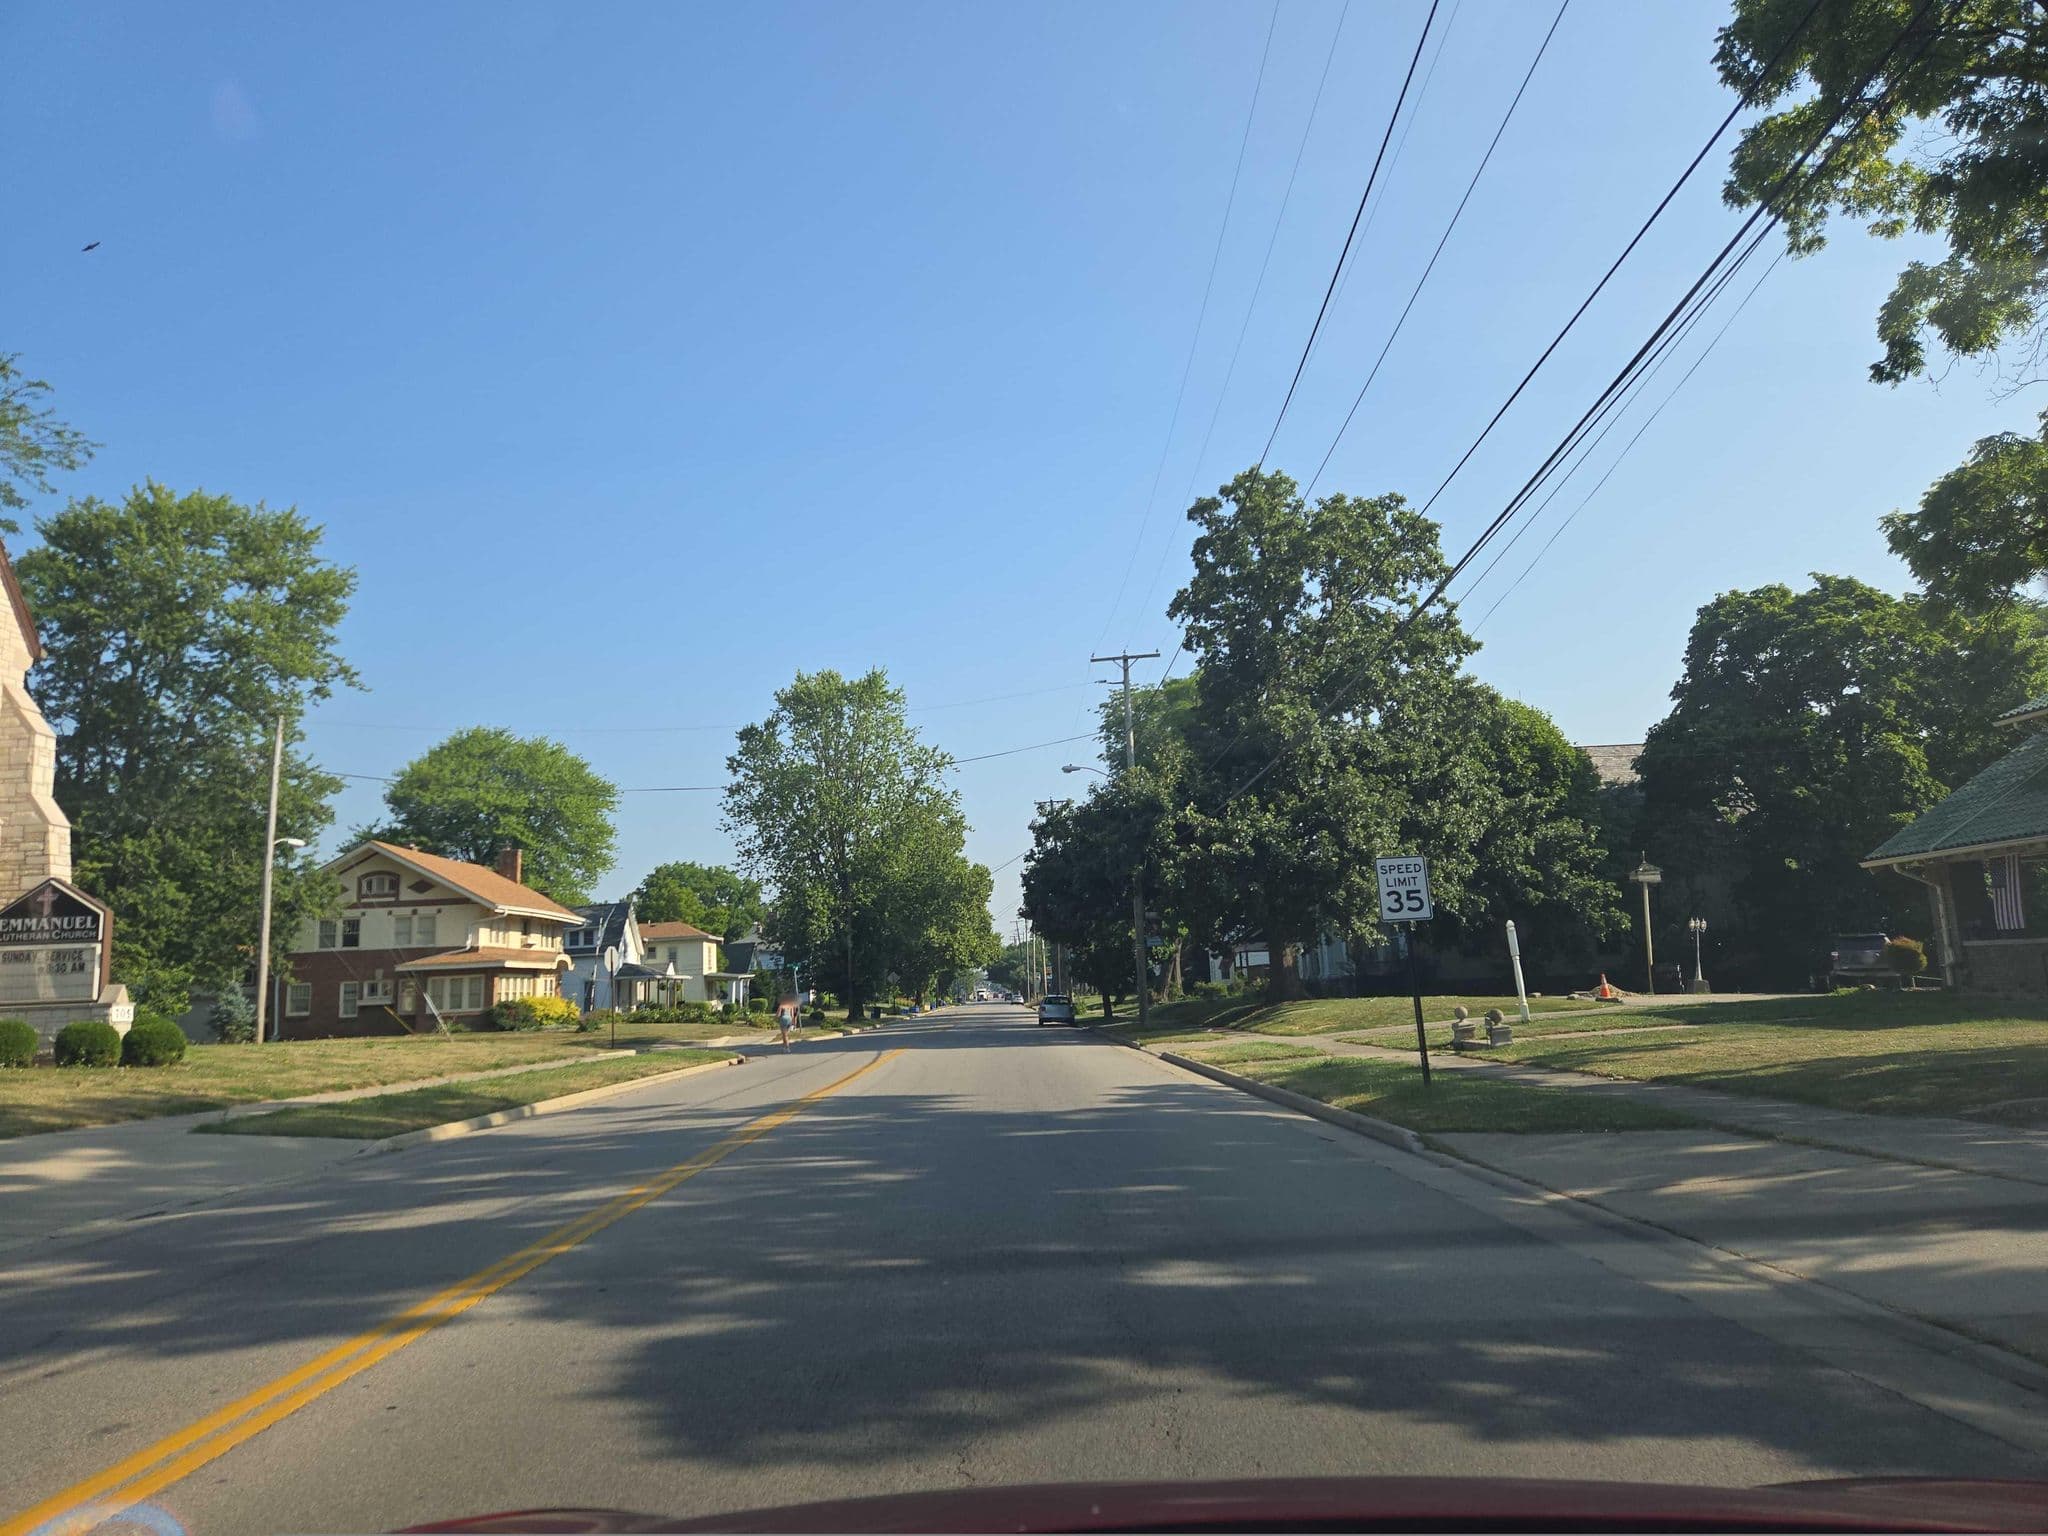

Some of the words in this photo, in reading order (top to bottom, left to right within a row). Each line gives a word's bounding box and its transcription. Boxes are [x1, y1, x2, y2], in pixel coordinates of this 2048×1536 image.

[1380, 863, 1422, 875] SPEED
[1386, 876, 1418, 888] LIMIT
[1386, 889, 1425, 913] 35
[0, 915, 97, 932] EMMANUEL
[52, 929, 97, 940] CHURCH
[1, 951, 38, 964] SUNDAY
